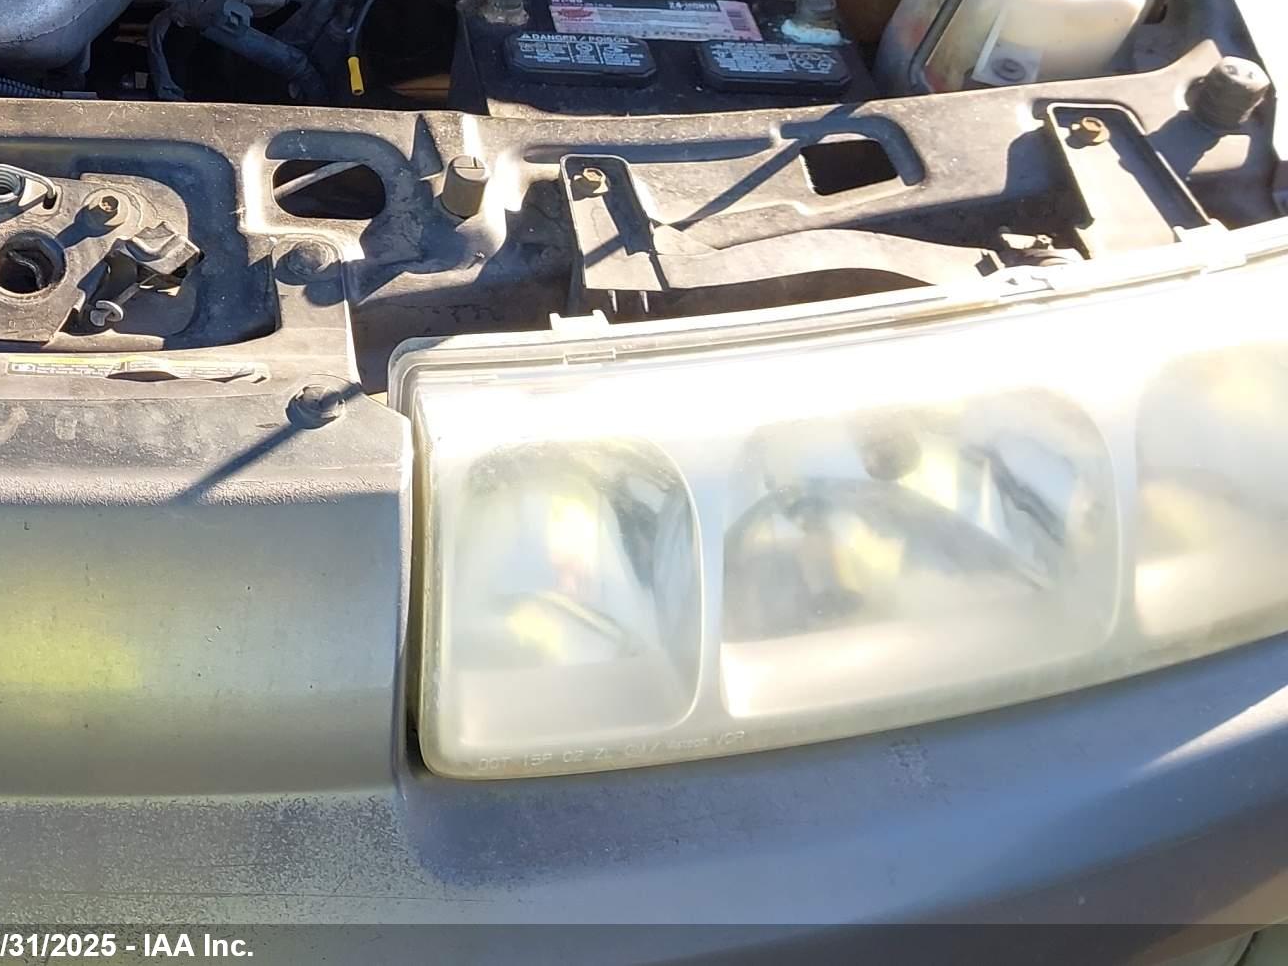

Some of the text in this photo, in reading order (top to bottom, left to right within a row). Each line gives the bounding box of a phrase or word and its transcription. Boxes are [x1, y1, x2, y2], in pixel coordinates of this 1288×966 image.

[531, 33, 577, 42] DANGER
[588, 35, 629, 43] POISON
[478, 756, 511, 770] DOT
